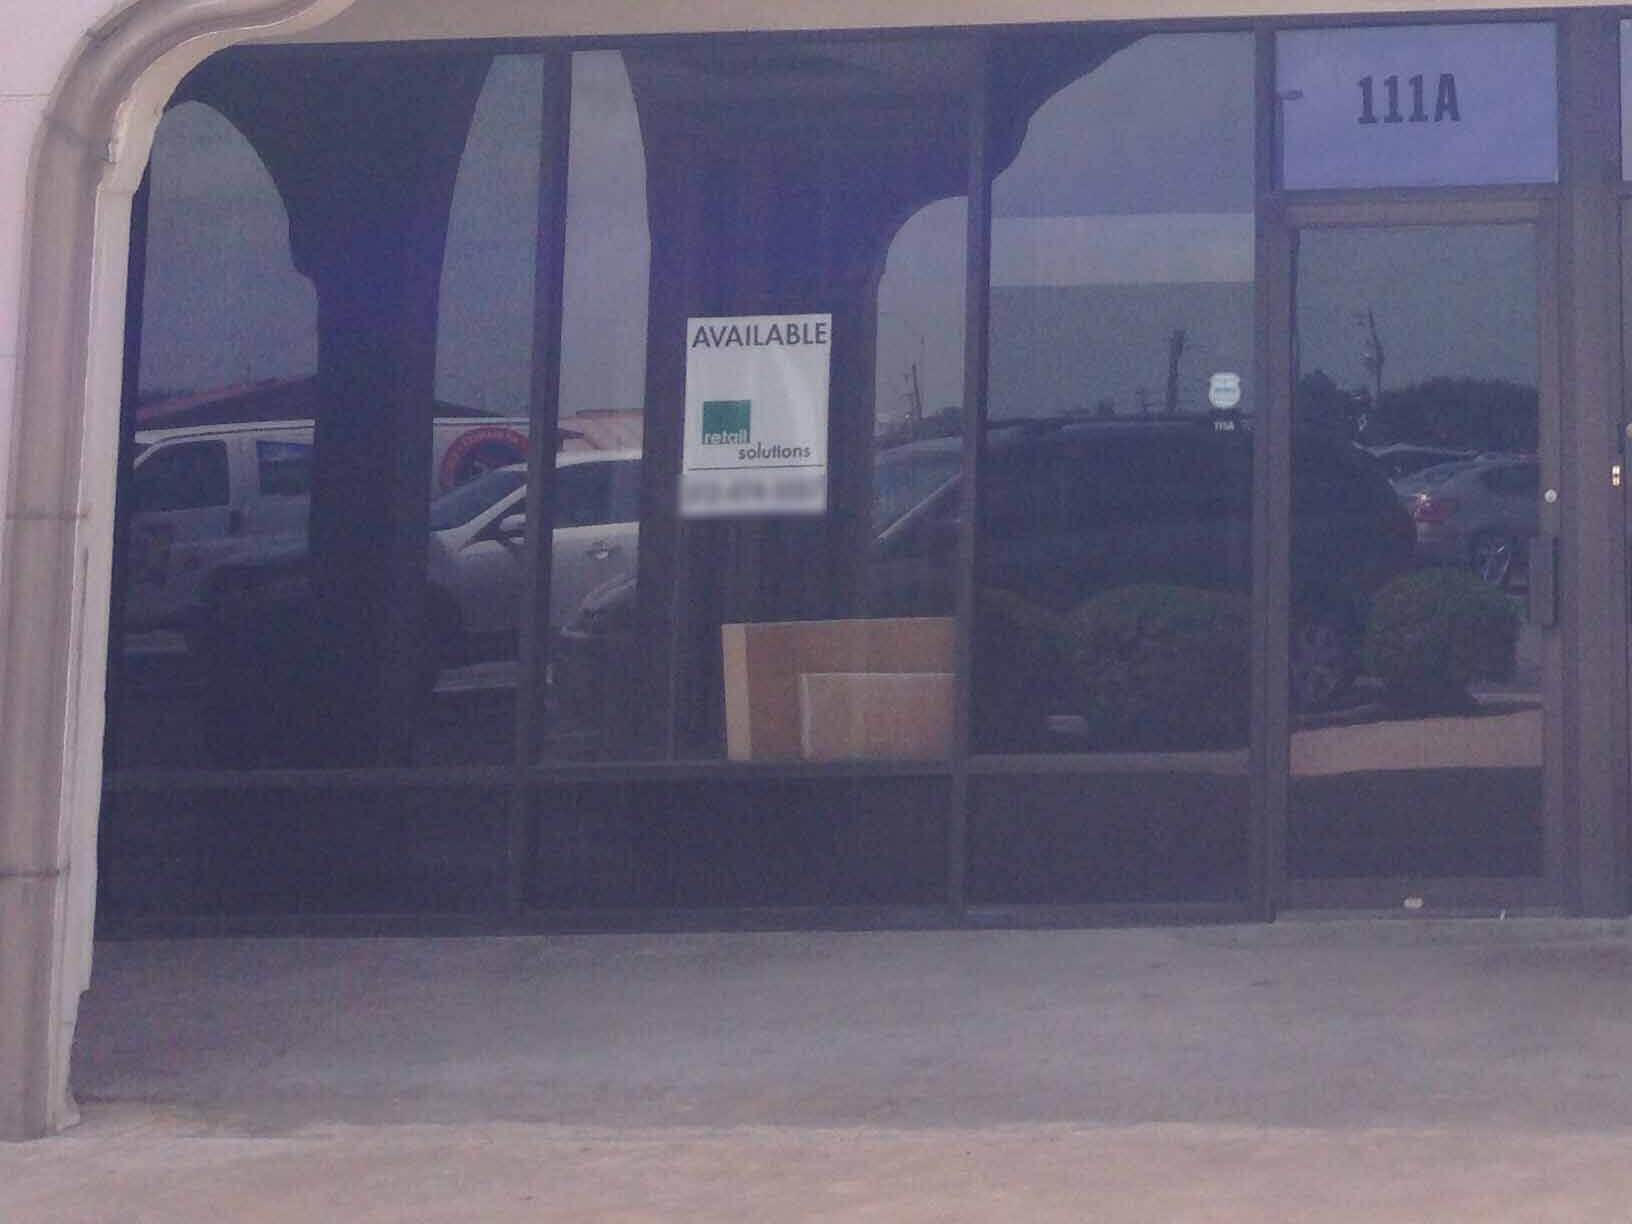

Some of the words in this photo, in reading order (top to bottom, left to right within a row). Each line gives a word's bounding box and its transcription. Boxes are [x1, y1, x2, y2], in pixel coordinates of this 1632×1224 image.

[1357, 73, 1460, 123] 111A
[691, 323, 828, 348] AVAILABLE
[704, 429, 748, 445] retail
[738, 442, 812, 460] solutions
